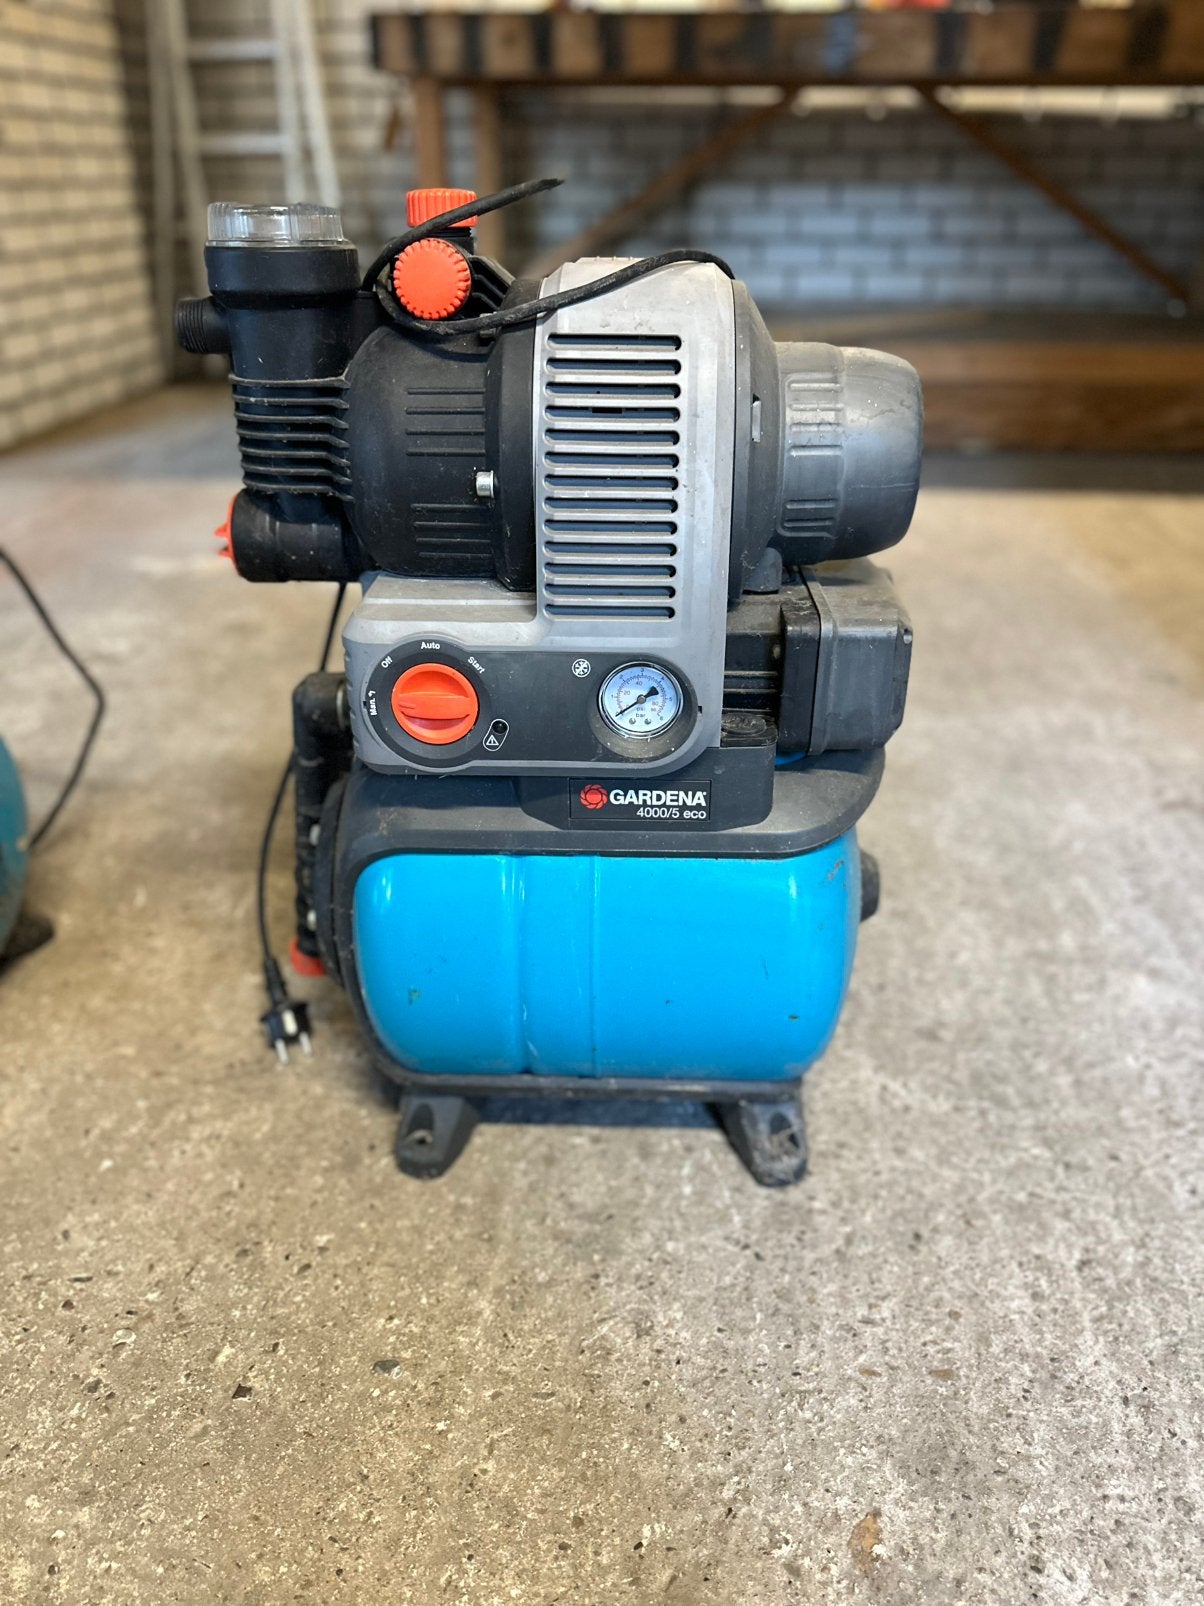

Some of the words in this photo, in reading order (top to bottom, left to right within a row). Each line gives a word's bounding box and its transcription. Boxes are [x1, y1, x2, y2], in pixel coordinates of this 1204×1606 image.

[420, 641, 441, 650] Auto
[381, 656, 393, 668] Off
[467, 656, 485, 674] Start
[609, 789, 706, 806] GARDENA
[636, 807, 680, 818] 4000/5
[683, 810, 707, 819] eco
